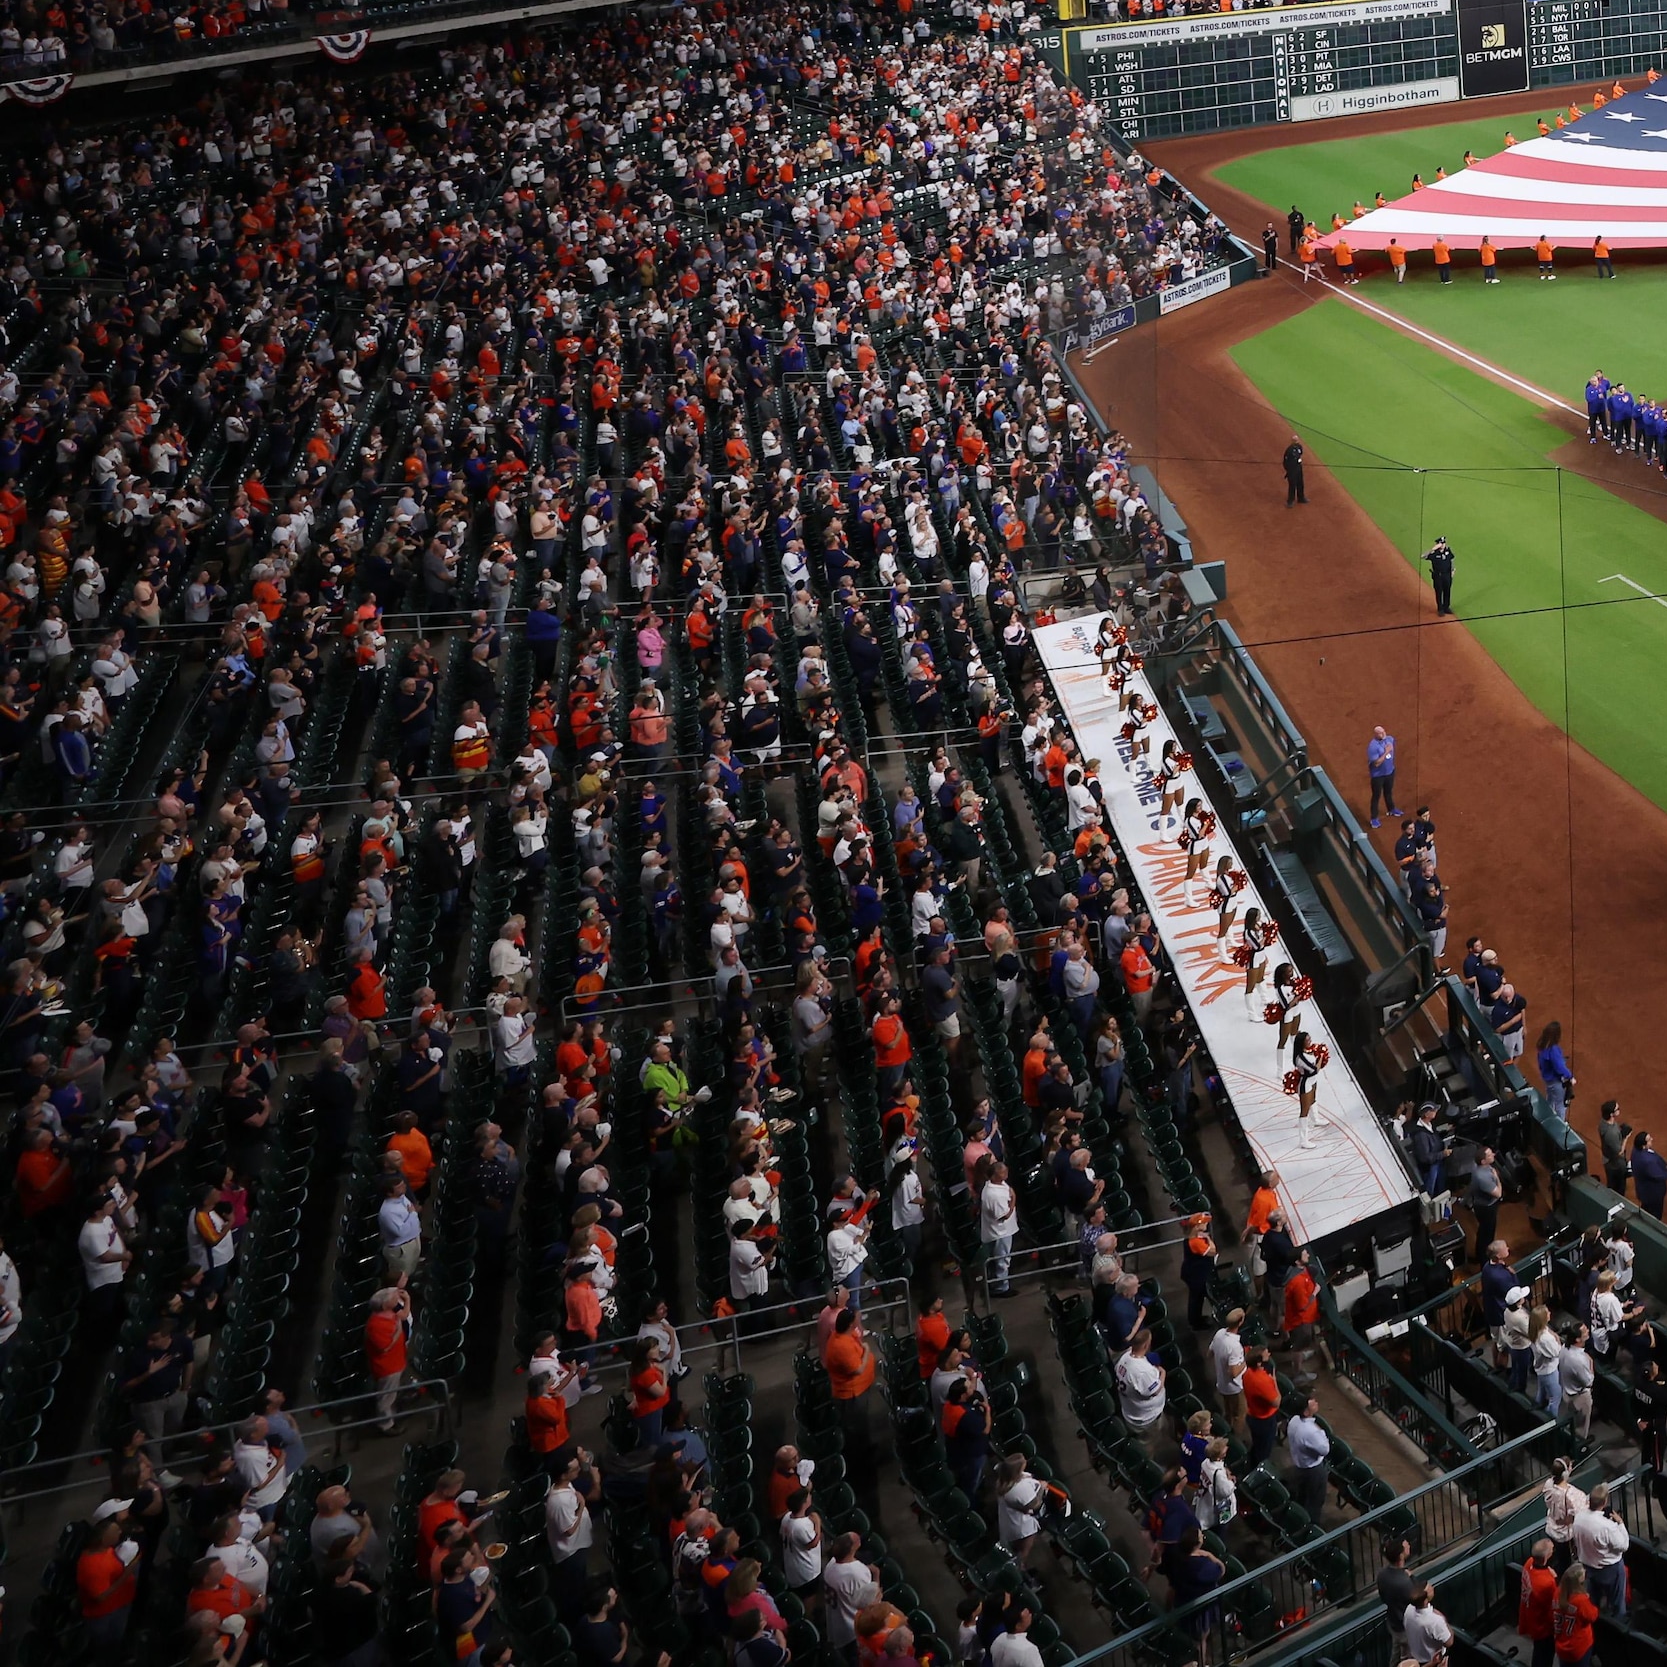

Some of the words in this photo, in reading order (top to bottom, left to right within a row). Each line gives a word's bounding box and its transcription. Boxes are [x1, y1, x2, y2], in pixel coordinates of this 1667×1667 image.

[1365, 0, 1439, 14] ASTROS.COM/TICKETS
[1552, 4, 1567, 13] MIL
[1279, 9, 1357, 24] ASTROS.COM/TICKETS
[1551, 13, 1569, 22] NYY
[1190, 17, 1270, 33] ASTROS.COM/TICKETS
[1552, 24, 1568, 33] BAL
[1096, 26, 1180, 43] ASTROS.COM/TICKETS
[1315, 30, 1327, 39] SF
[1553, 34, 1568, 42] TOR
[1315, 40, 1330, 49] CIN
[1552, 45, 1570, 54] LAA
[1117, 52, 1135, 61] PHI
[1316, 52, 1329, 61] PIT
[1466, 47, 1523, 64] BETMGM
[1552, 54, 1571, 63] CWS
[1115, 62, 1138, 71] WSH
[1314, 62, 1333, 71] MIA
[1119, 75, 1136, 84] ATL
[1275, 36, 1288, 119] NATIONAL
[1316, 73, 1332, 82] DET
[1121, 85, 1135, 94] SD
[1315, 83, 1334, 93] LAD
[1118, 97, 1140, 107] MIN
[1342, 88, 1440, 110] Higginbotham
[1119, 107, 1138, 117] STL
[1122, 120, 1138, 130] CHI
[1122, 129, 1139, 139] ARI
